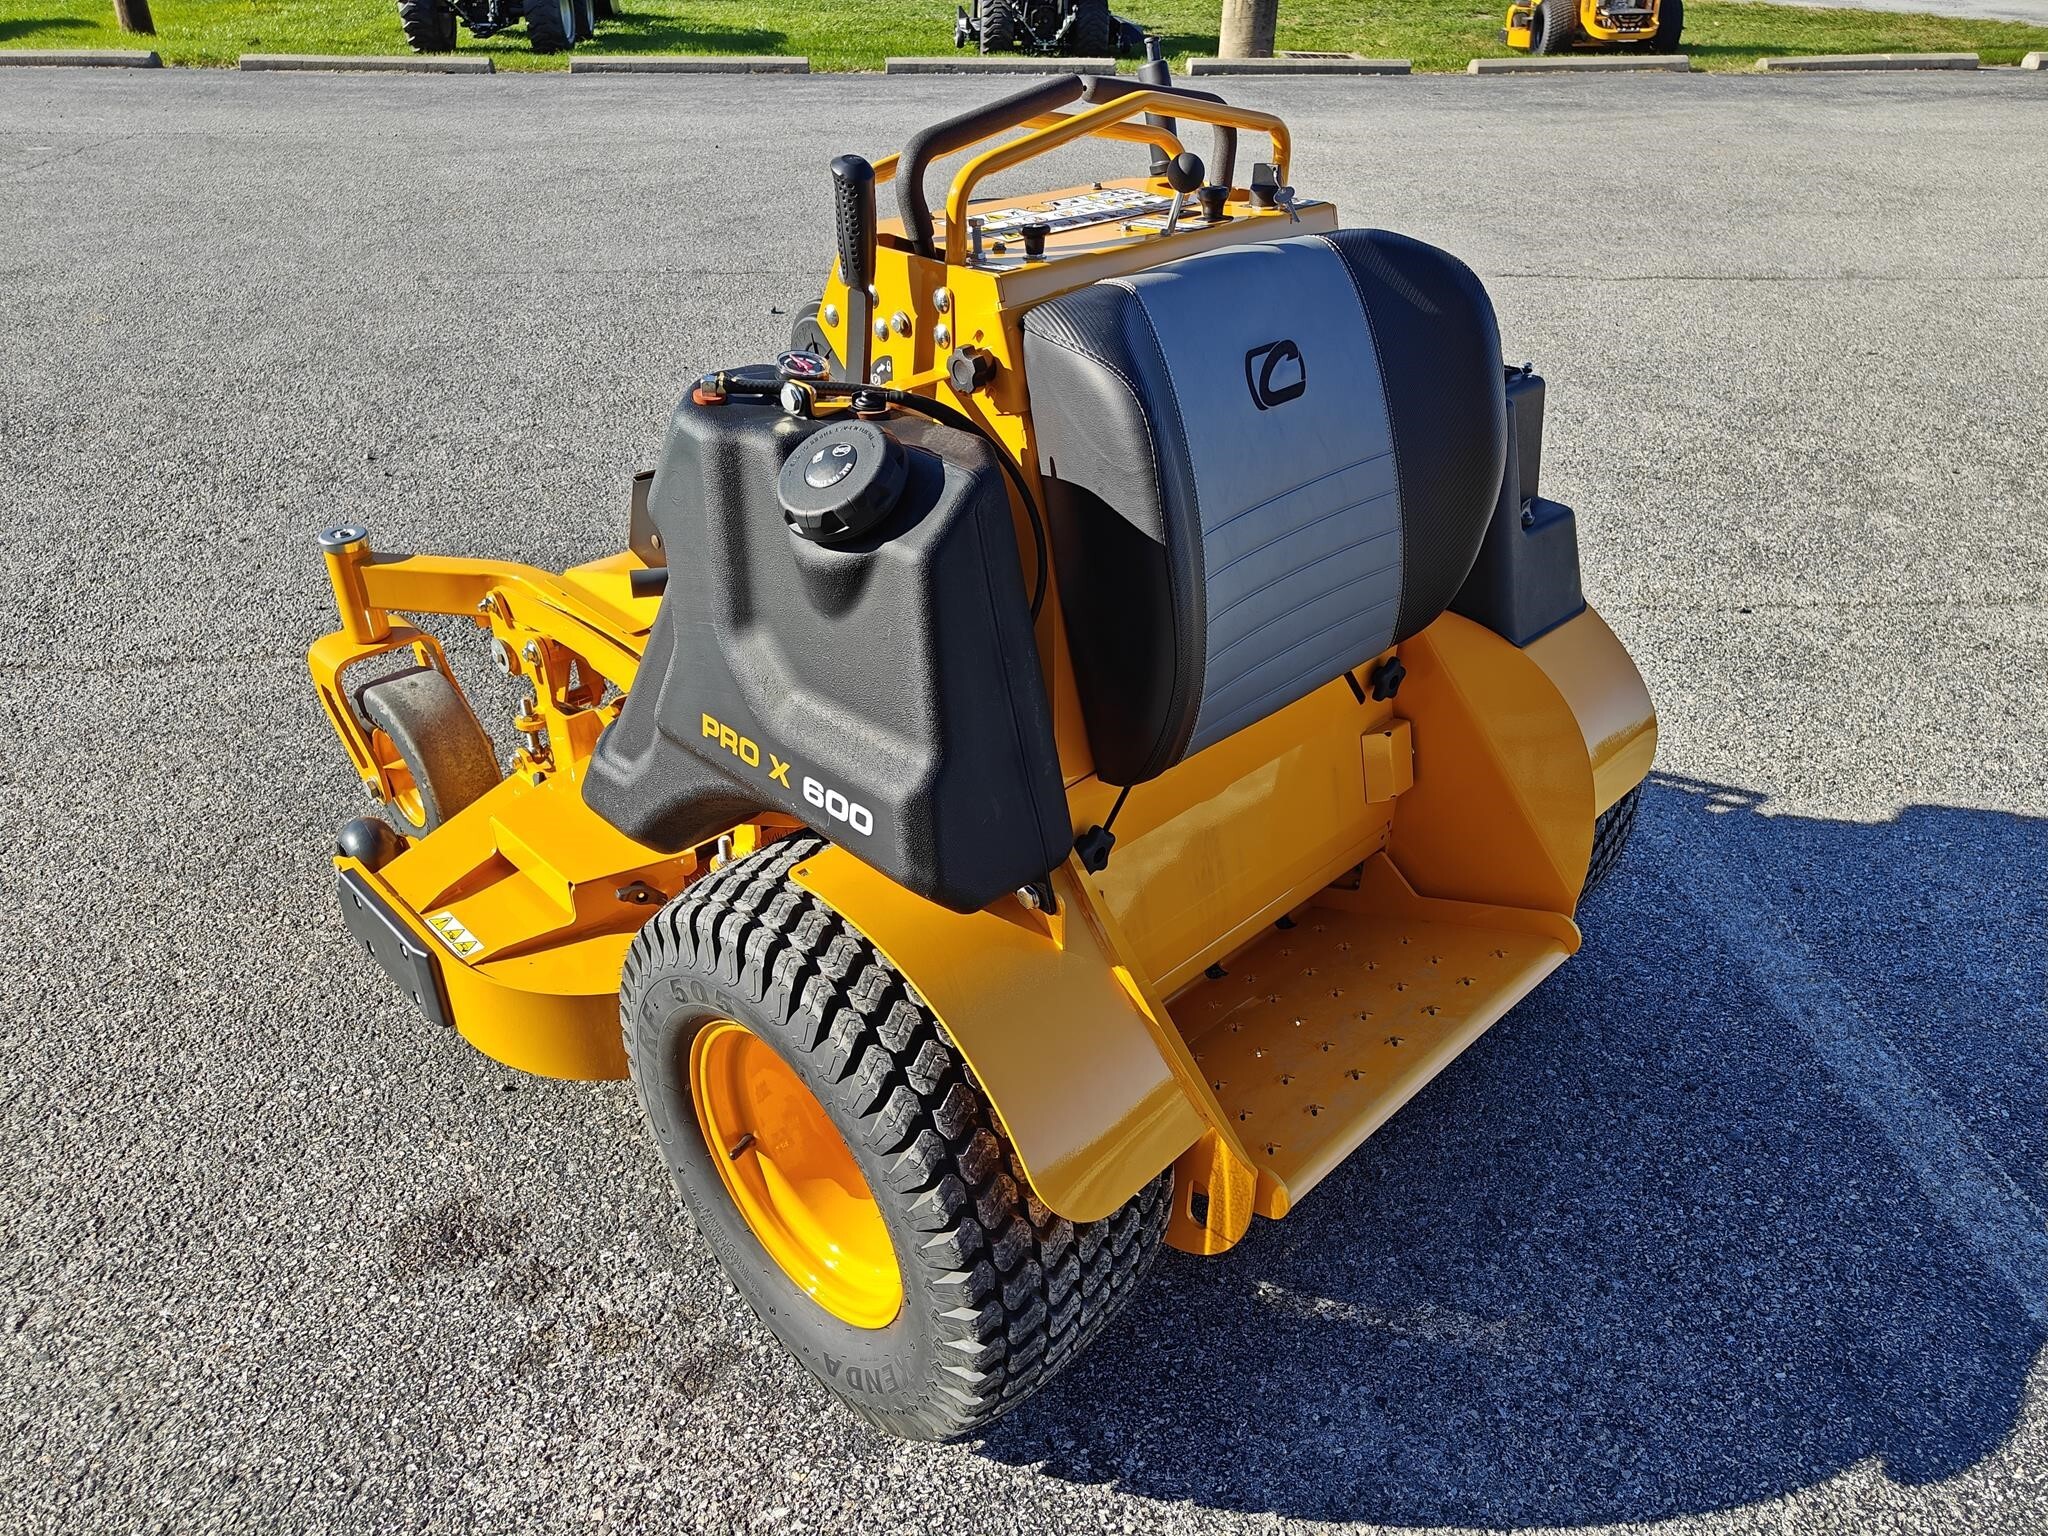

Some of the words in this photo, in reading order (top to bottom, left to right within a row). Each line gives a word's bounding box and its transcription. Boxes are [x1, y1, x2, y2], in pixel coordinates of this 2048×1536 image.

[702, 713, 760, 768] PRO
[768, 753, 791, 789] X
[802, 776, 873, 836] 600
[669, 978, 735, 1016] 505
